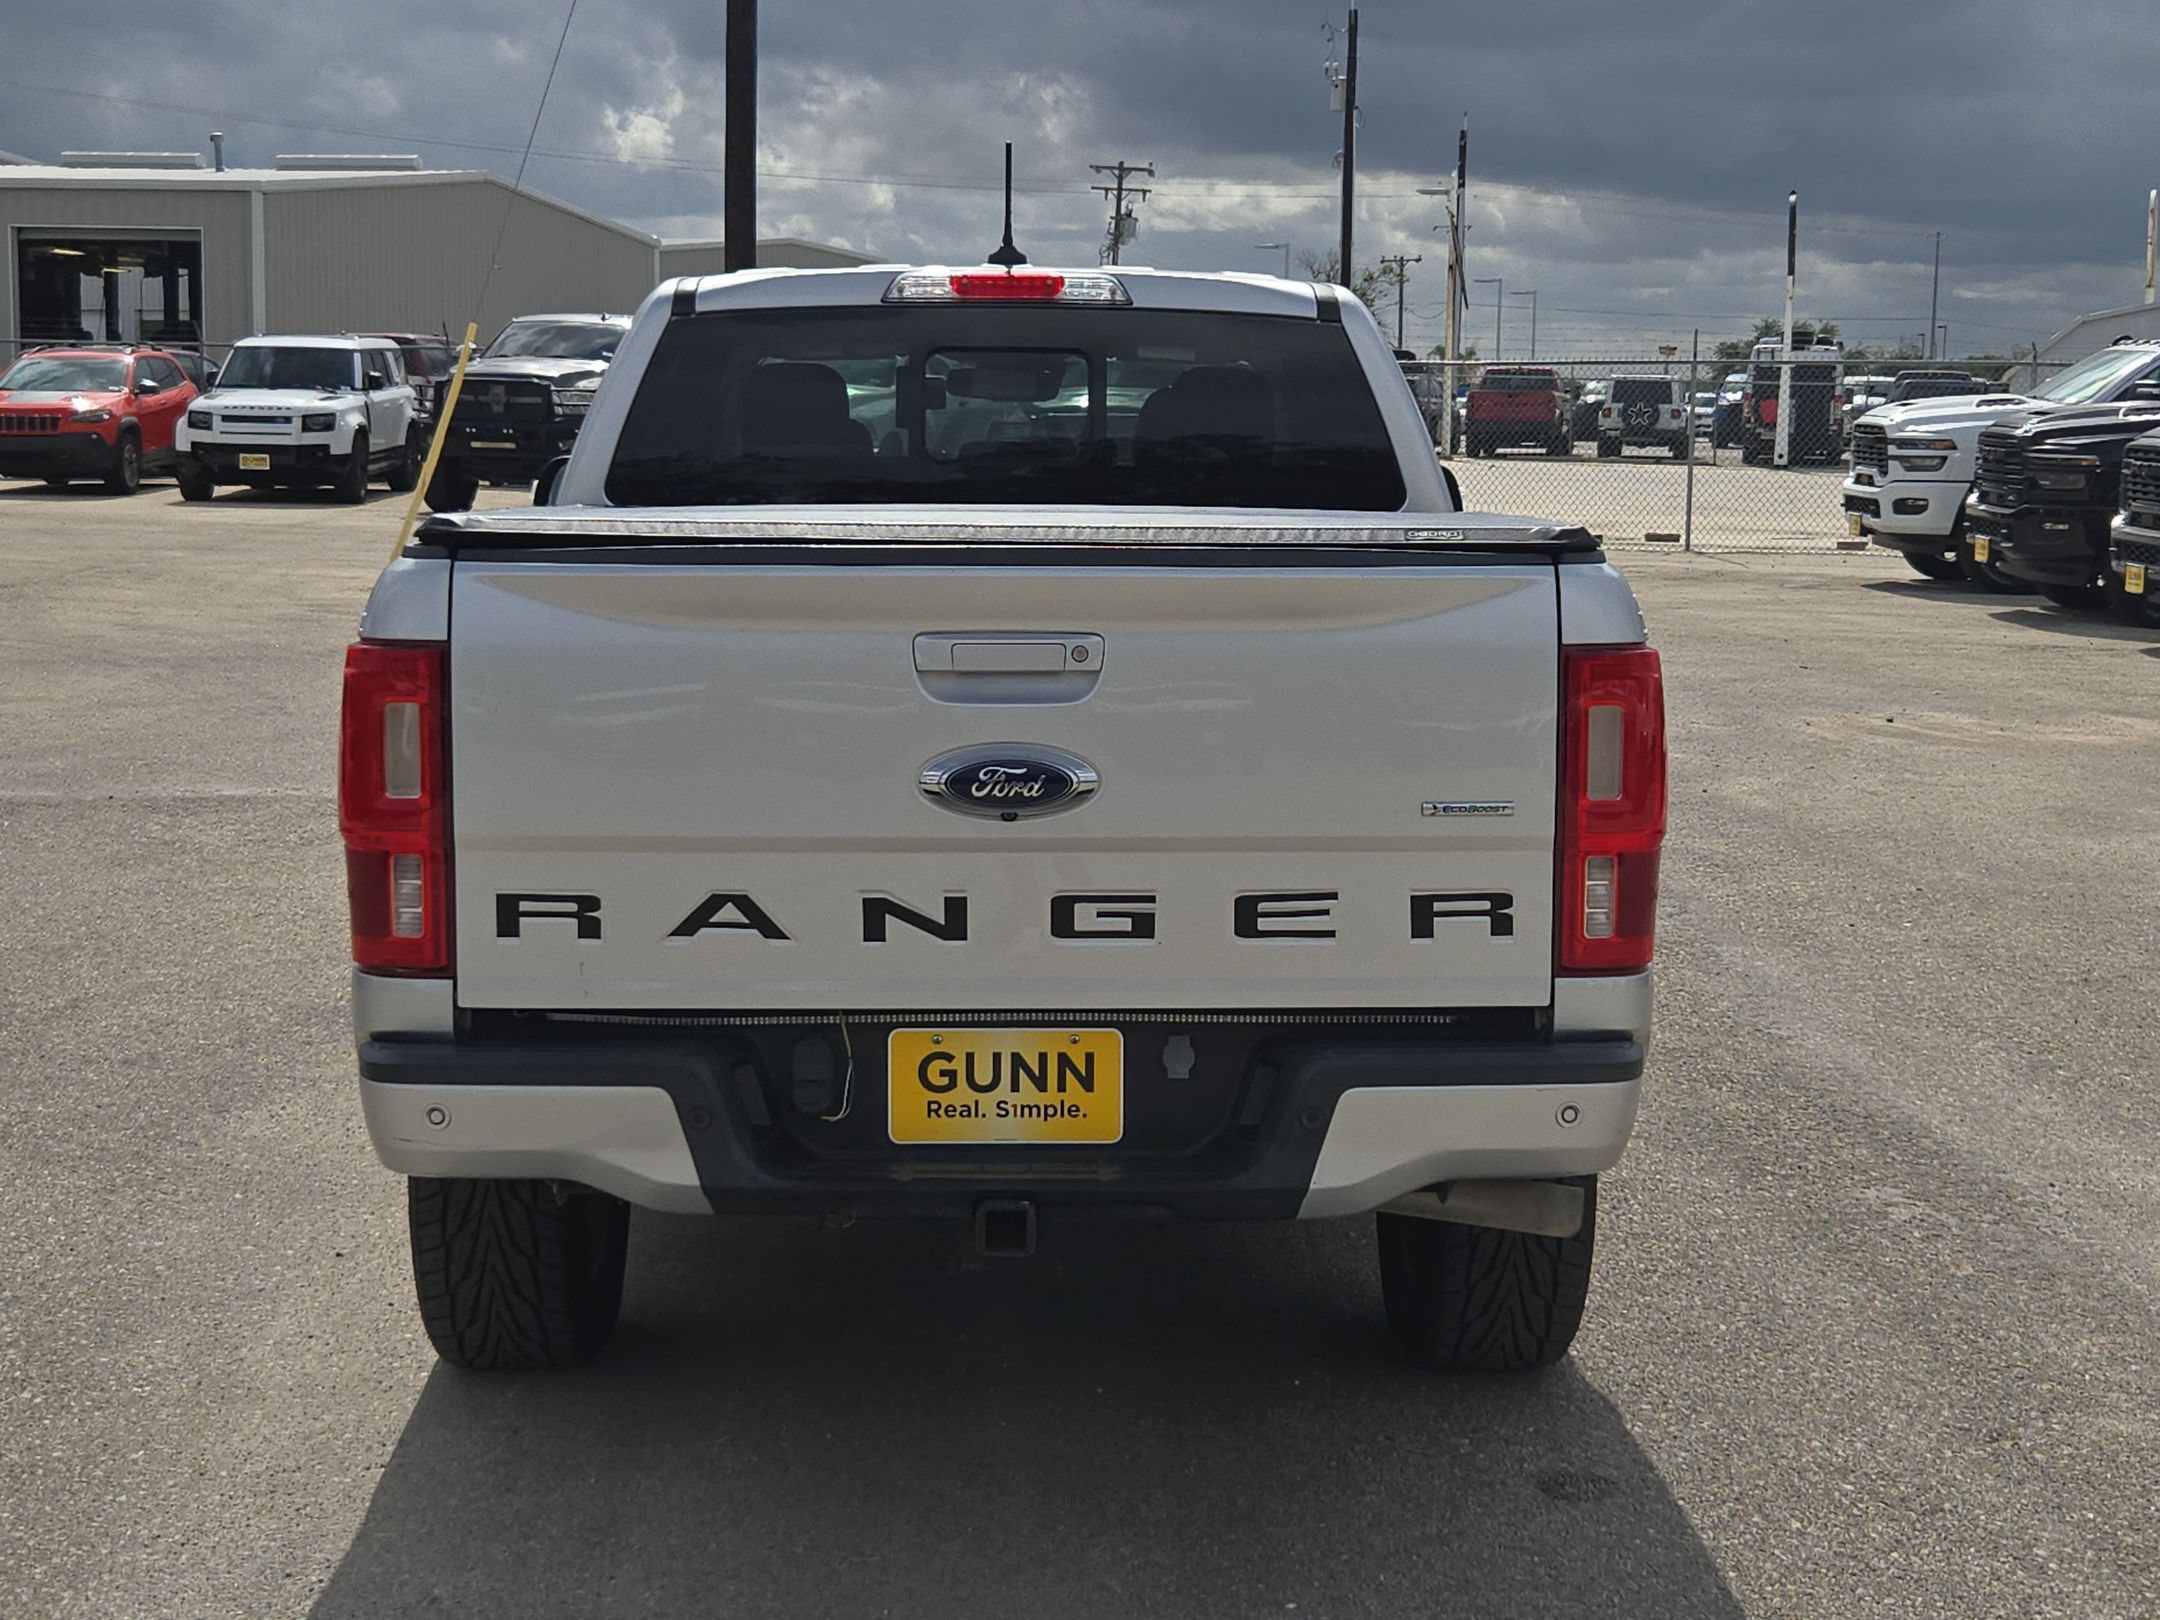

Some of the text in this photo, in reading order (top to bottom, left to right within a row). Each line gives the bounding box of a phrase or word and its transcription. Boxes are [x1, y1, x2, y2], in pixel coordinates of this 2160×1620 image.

[971, 766, 1046, 798] Ford
[495, 888, 1514, 943] RANGER
[917, 1050, 1095, 1094] GUNN
[926, 1100, 987, 1119] Real.
